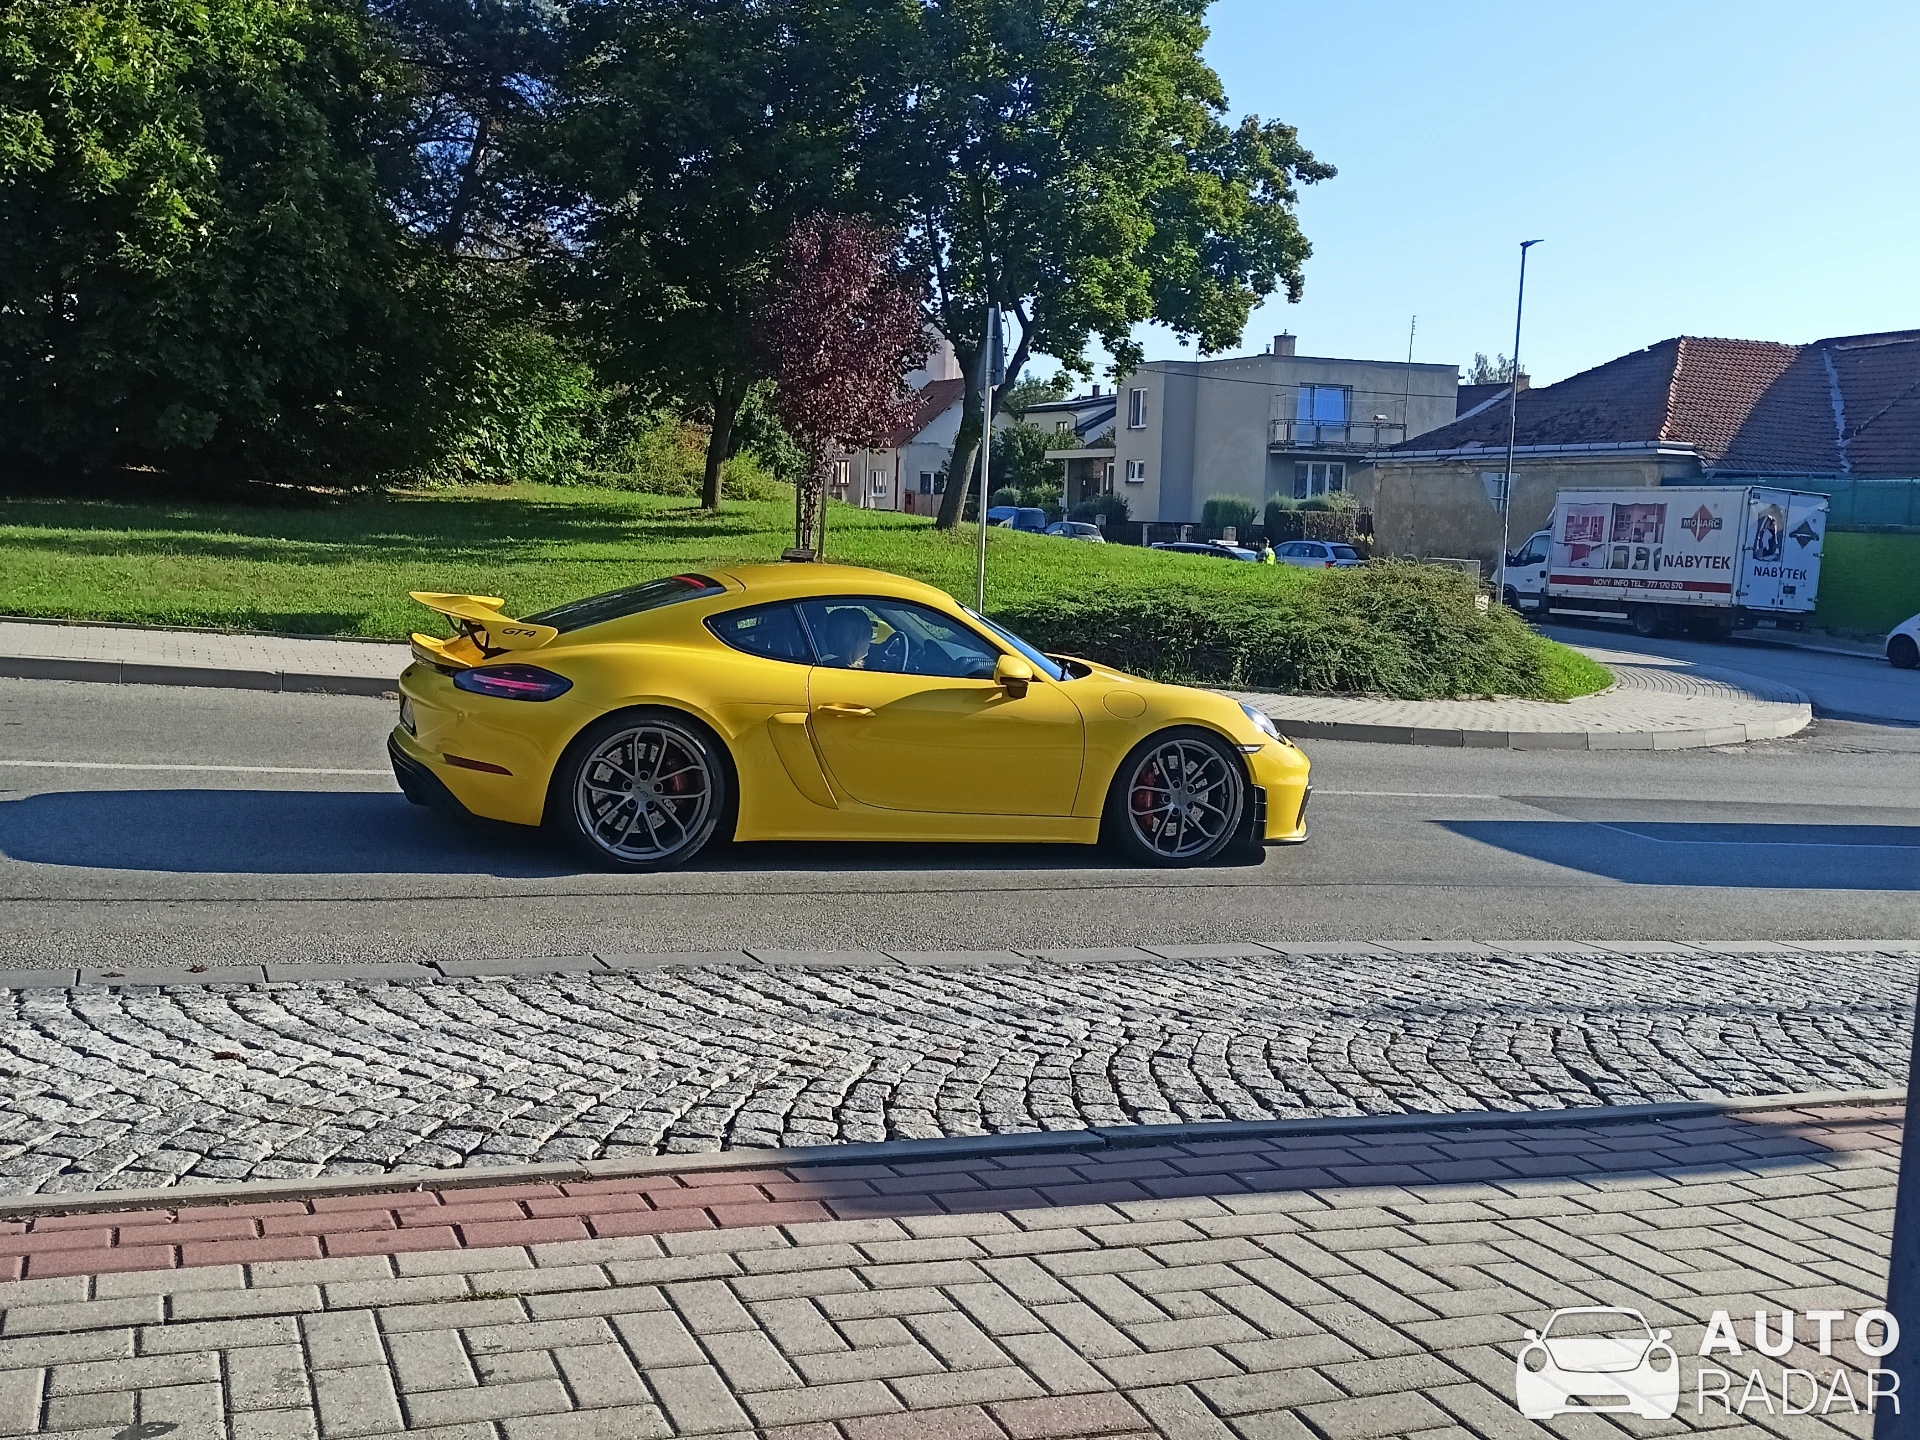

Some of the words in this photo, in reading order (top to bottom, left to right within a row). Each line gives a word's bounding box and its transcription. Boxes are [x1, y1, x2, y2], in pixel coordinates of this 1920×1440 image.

[1663, 551, 1731, 570] NÁBYTEK
[1613, 579, 1629, 587] INFO
[1646, 580, 1658, 588] 777
[1659, 581, 1670, 589] 170
[502, 628, 537, 638] GT4
